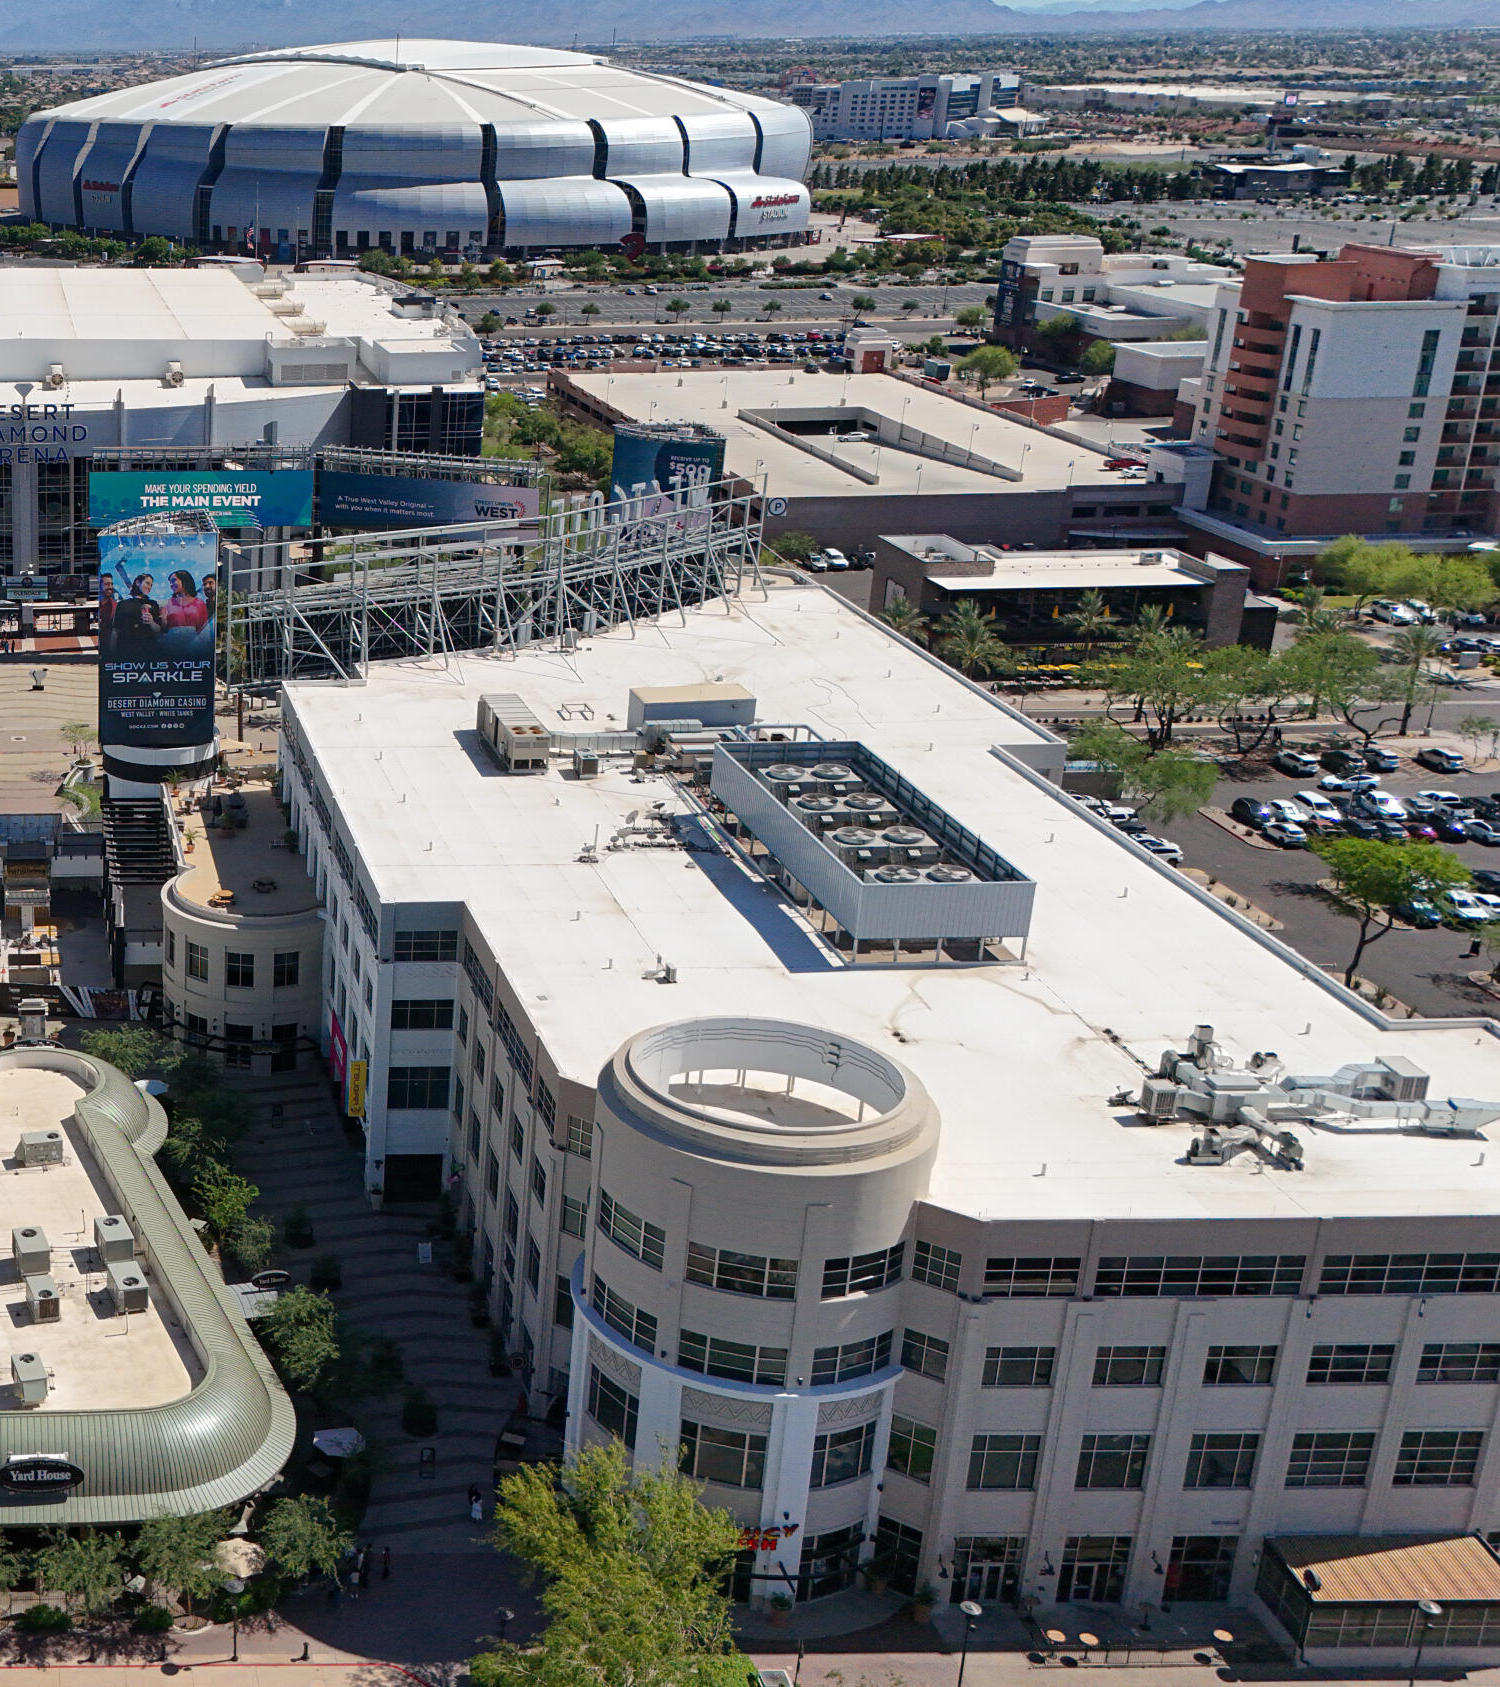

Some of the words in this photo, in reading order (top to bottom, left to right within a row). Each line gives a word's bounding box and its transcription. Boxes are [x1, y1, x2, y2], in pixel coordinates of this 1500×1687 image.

[669, 460, 709, 476] $500
[144, 484, 166, 494] MAKE
[168, 484, 191, 494] YOUR
[192, 483, 232, 494] SPENDING
[233, 483, 257, 493] YIELD
[140, 496, 169, 507] THE
[171, 496, 210, 507] MAIN
[212, 495, 261, 507] EVENT
[360, 497, 377, 505] West
[378, 498, 399, 507] Valley
[399, 500, 427, 509] Original
[389, 508, 415, 516] matters
[474, 505, 518, 519] WEST
[104, 662, 145, 671] SHOW
[149, 661, 169, 670] US
[173, 660, 211, 669] YOUR
[112, 671, 203, 683] SPARKLE
[107, 699, 136, 709] DESERT
[139, 698, 175, 708] DIAMOND
[177, 697, 207, 707] CASINO
[120, 710, 135, 718] WEST
[10, 1470, 35, 1482] Yard
[36, 1469, 72, 1481] House
